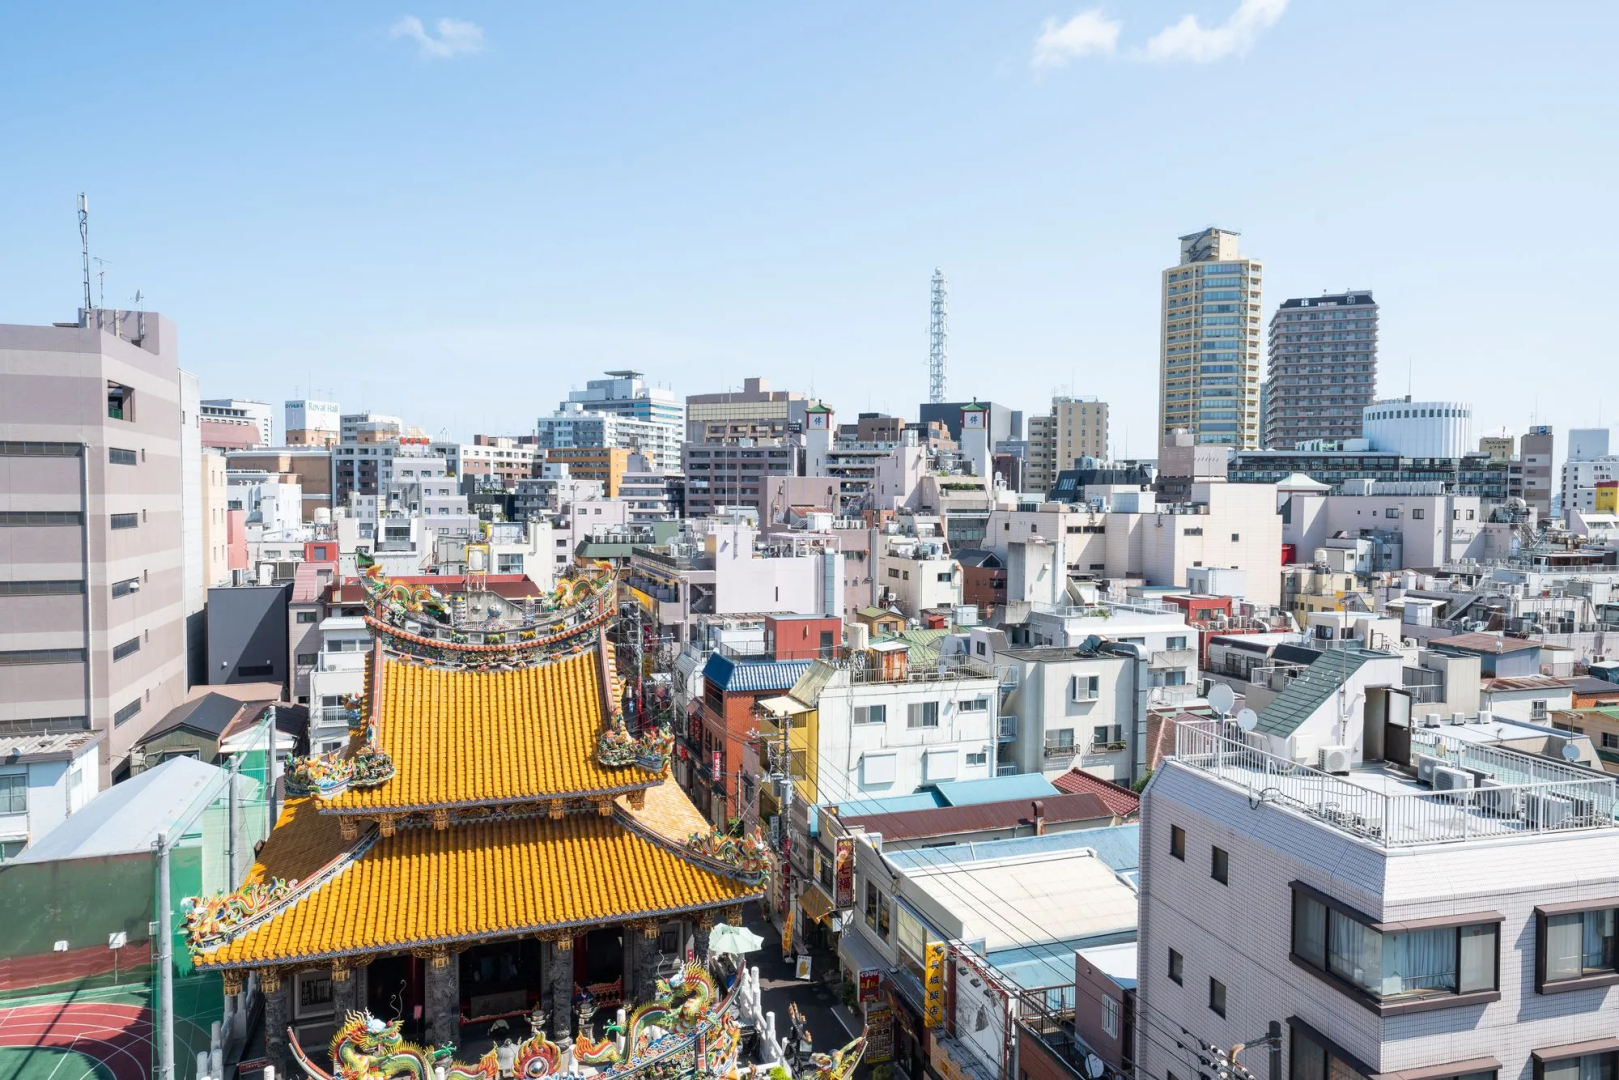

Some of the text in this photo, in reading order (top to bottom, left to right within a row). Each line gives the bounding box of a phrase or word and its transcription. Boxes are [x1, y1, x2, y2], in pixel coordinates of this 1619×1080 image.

[308, 402, 326, 412] Royal
[327, 404, 338, 413] Hall
[839, 864, 850, 890] 七福
[929, 959, 939, 1016] 長城飯店
